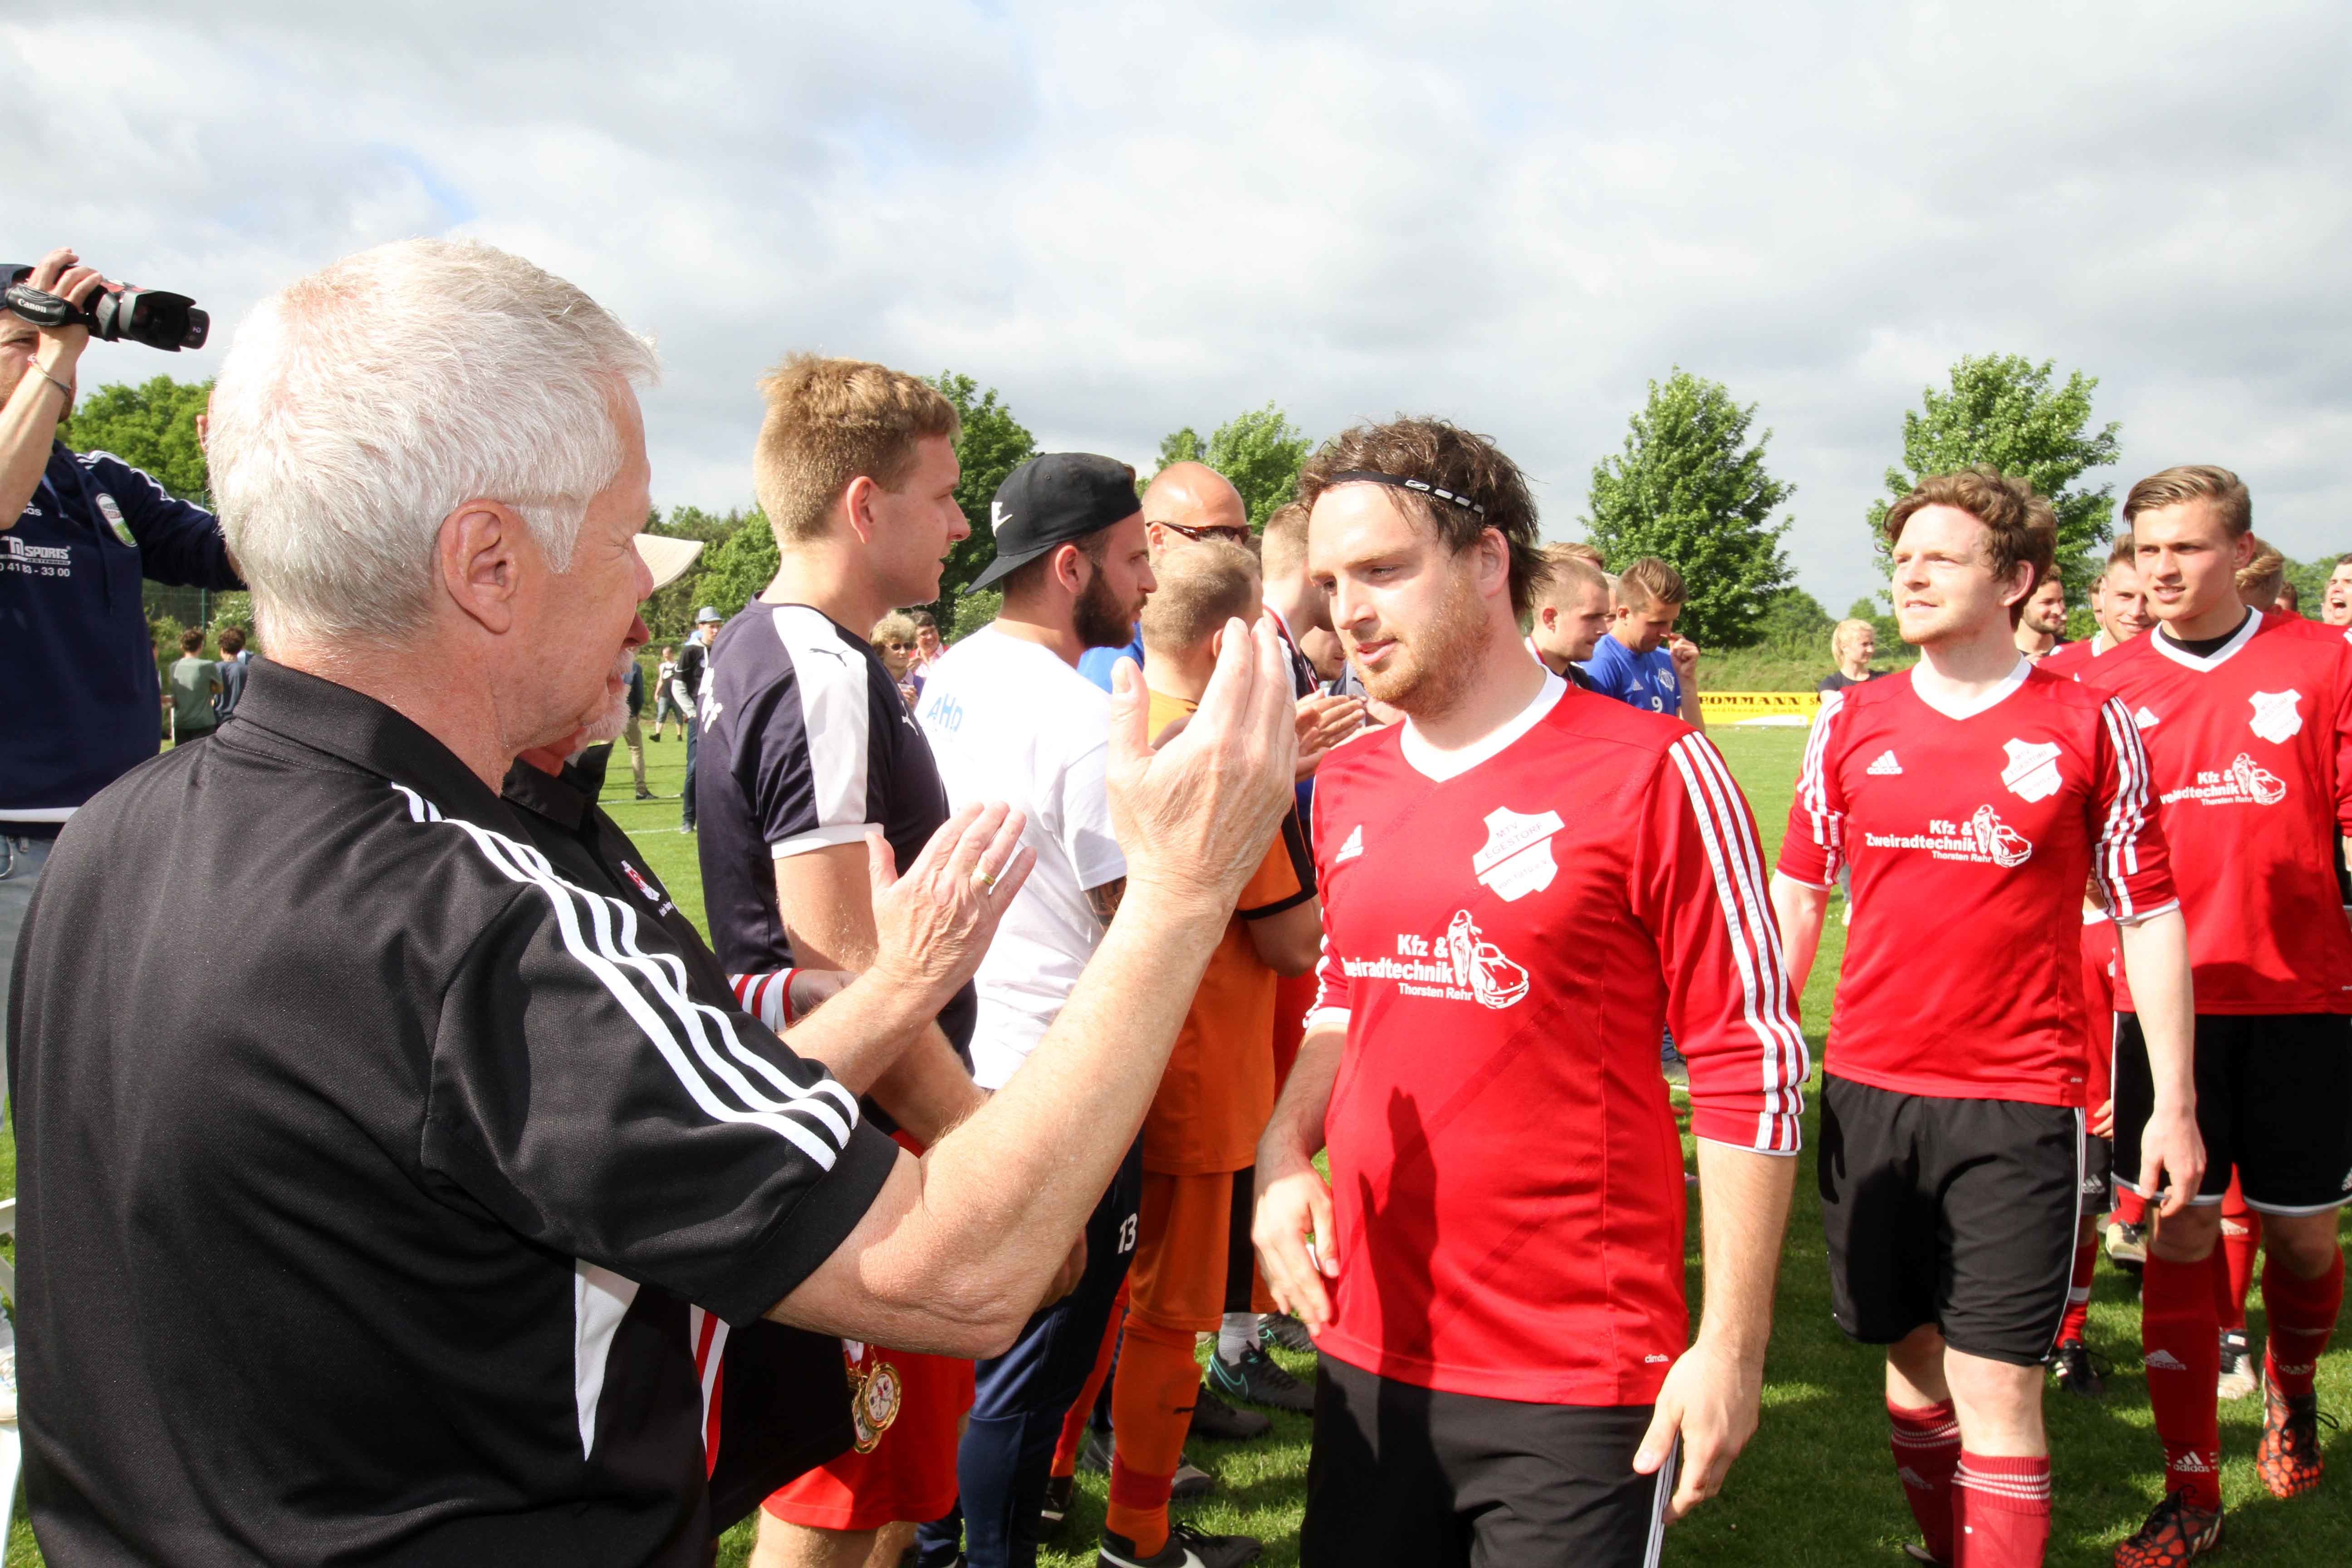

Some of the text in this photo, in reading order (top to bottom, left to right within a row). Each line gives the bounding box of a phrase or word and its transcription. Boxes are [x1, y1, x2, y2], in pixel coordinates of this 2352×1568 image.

[17, 298, 47, 313] Canon
[24, 545, 69, 559] SPORTS
[41, 567, 54, 576] 33
[57, 568, 70, 577] 00
[1651, 696, 1663, 713] 9
[2197, 769, 2234, 784] Kfz &
[2201, 797, 2234, 805] Thorsten
[1496, 822, 1518, 838] MTV
[1930, 820, 1973, 836] Kfz &
[1485, 822, 1543, 859] EGESTORF
[1865, 833, 1976, 852] Zweiradtechnik
[1931, 851, 1992, 863] Thorsten Rehr
[1397, 934, 1449, 958] Kfz &
[1398, 982, 1474, 1001] Thorsten Rehr
[1117, 1213, 1137, 1254] 13
[2174, 1464, 2210, 1472] adidas
